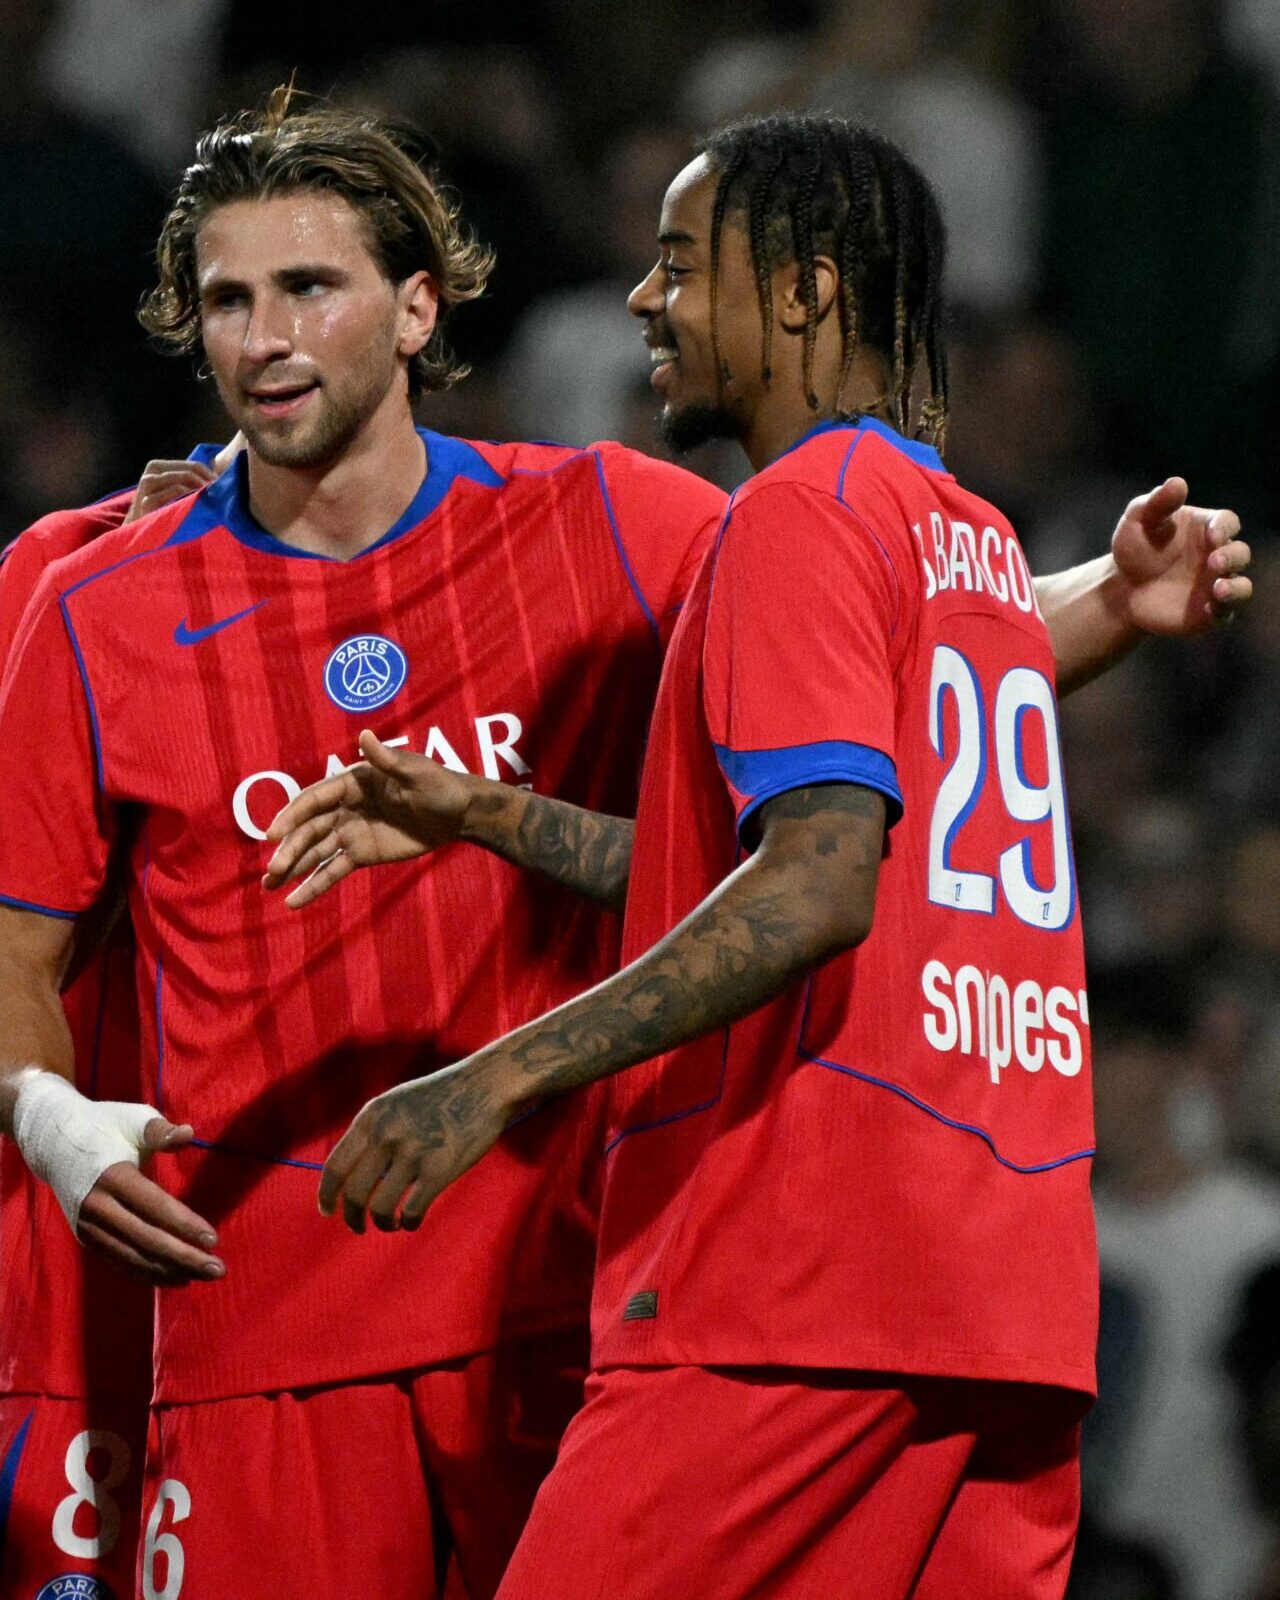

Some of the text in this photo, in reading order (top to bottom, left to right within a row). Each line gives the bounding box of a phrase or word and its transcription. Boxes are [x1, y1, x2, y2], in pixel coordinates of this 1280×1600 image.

[336, 641, 388, 664] PARIS
[928, 643, 1075, 932] 29
[52, 1430, 131, 1559] 8
[142, 1478, 192, 1600] 6
